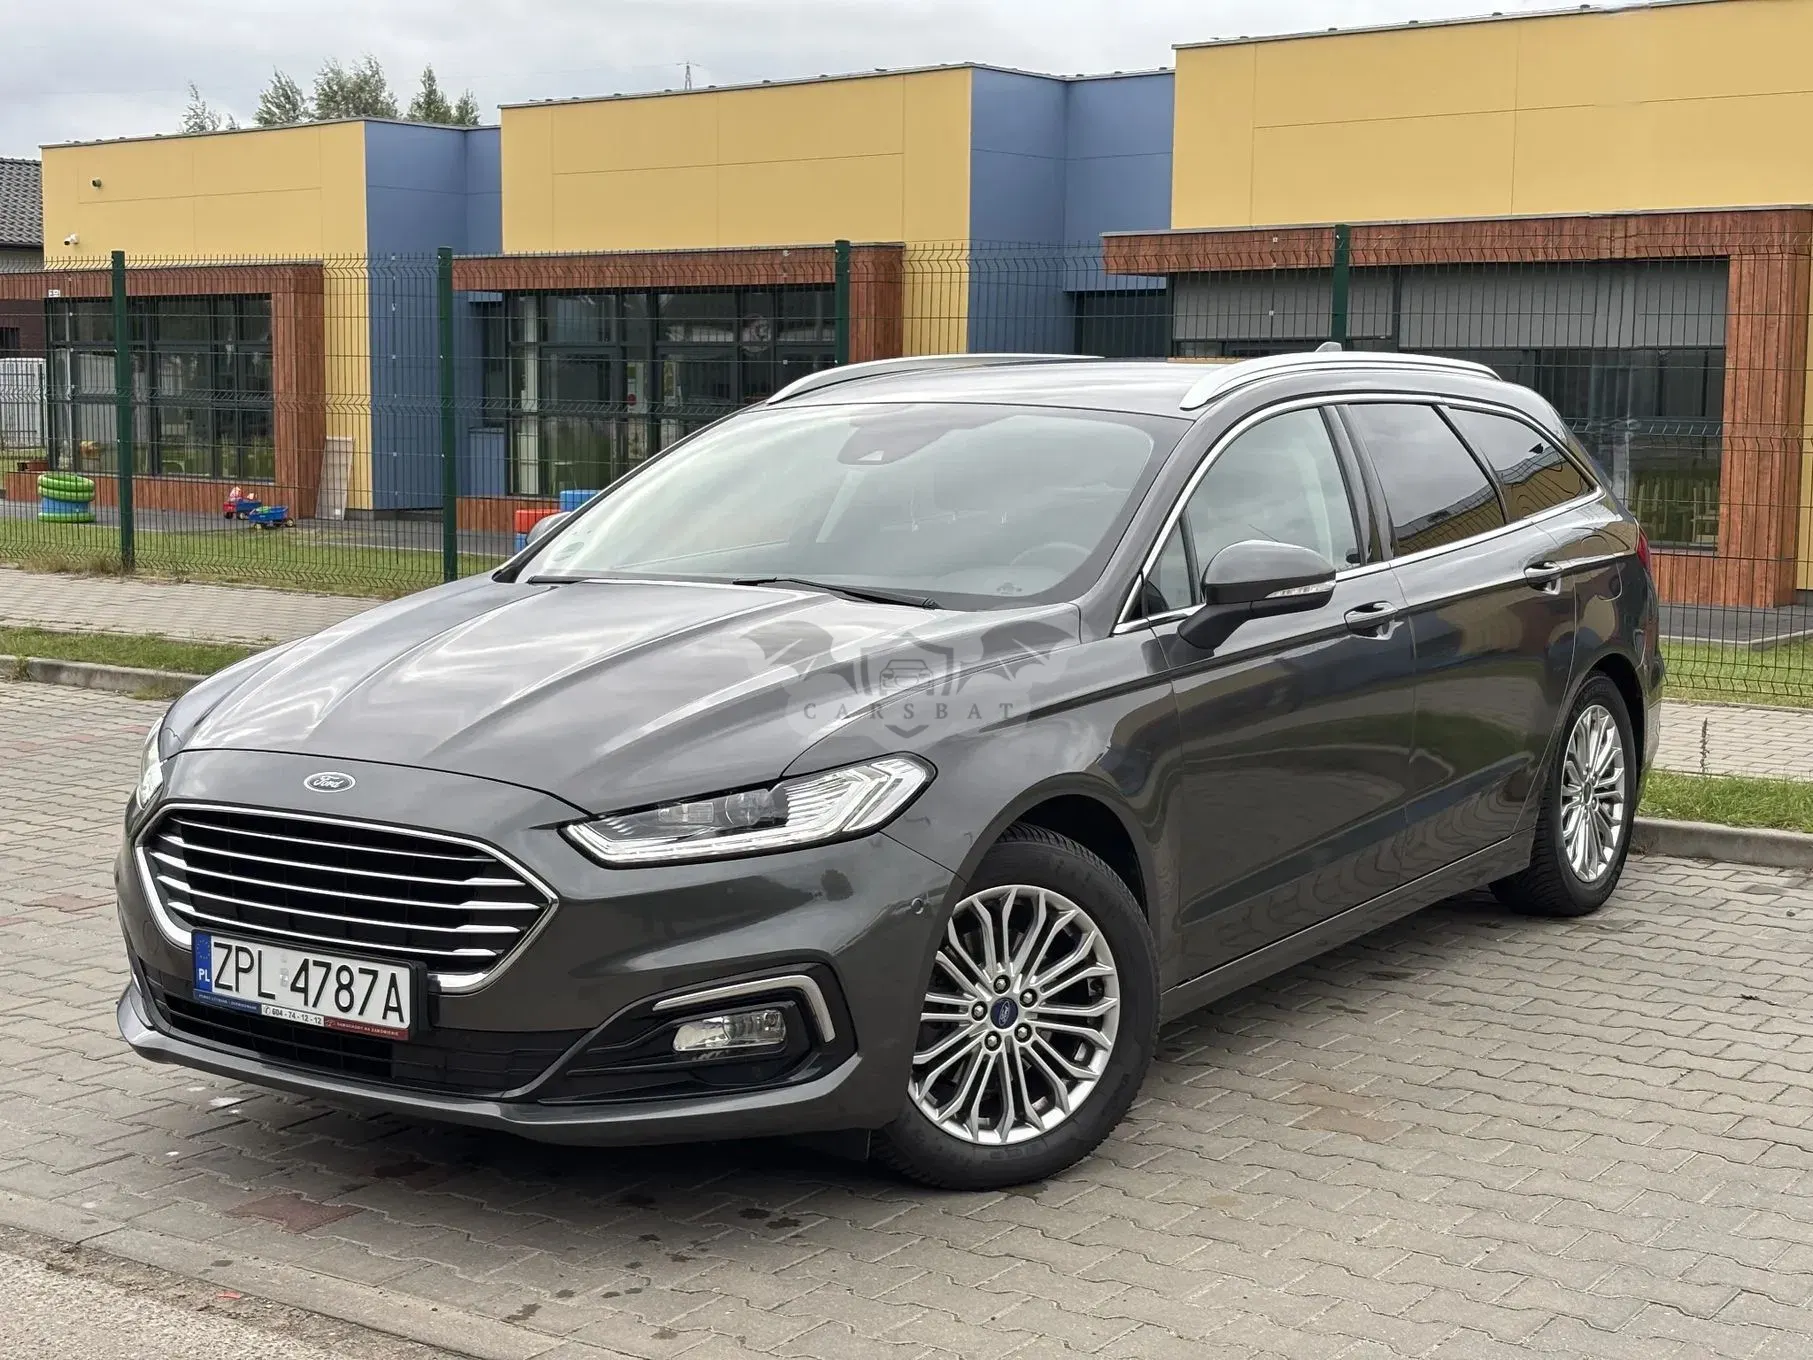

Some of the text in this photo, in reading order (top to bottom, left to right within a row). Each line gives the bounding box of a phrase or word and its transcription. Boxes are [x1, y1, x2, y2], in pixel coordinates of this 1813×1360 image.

[198, 967, 211, 983] PL
[213, 941, 405, 1023] ZPL 4787A
